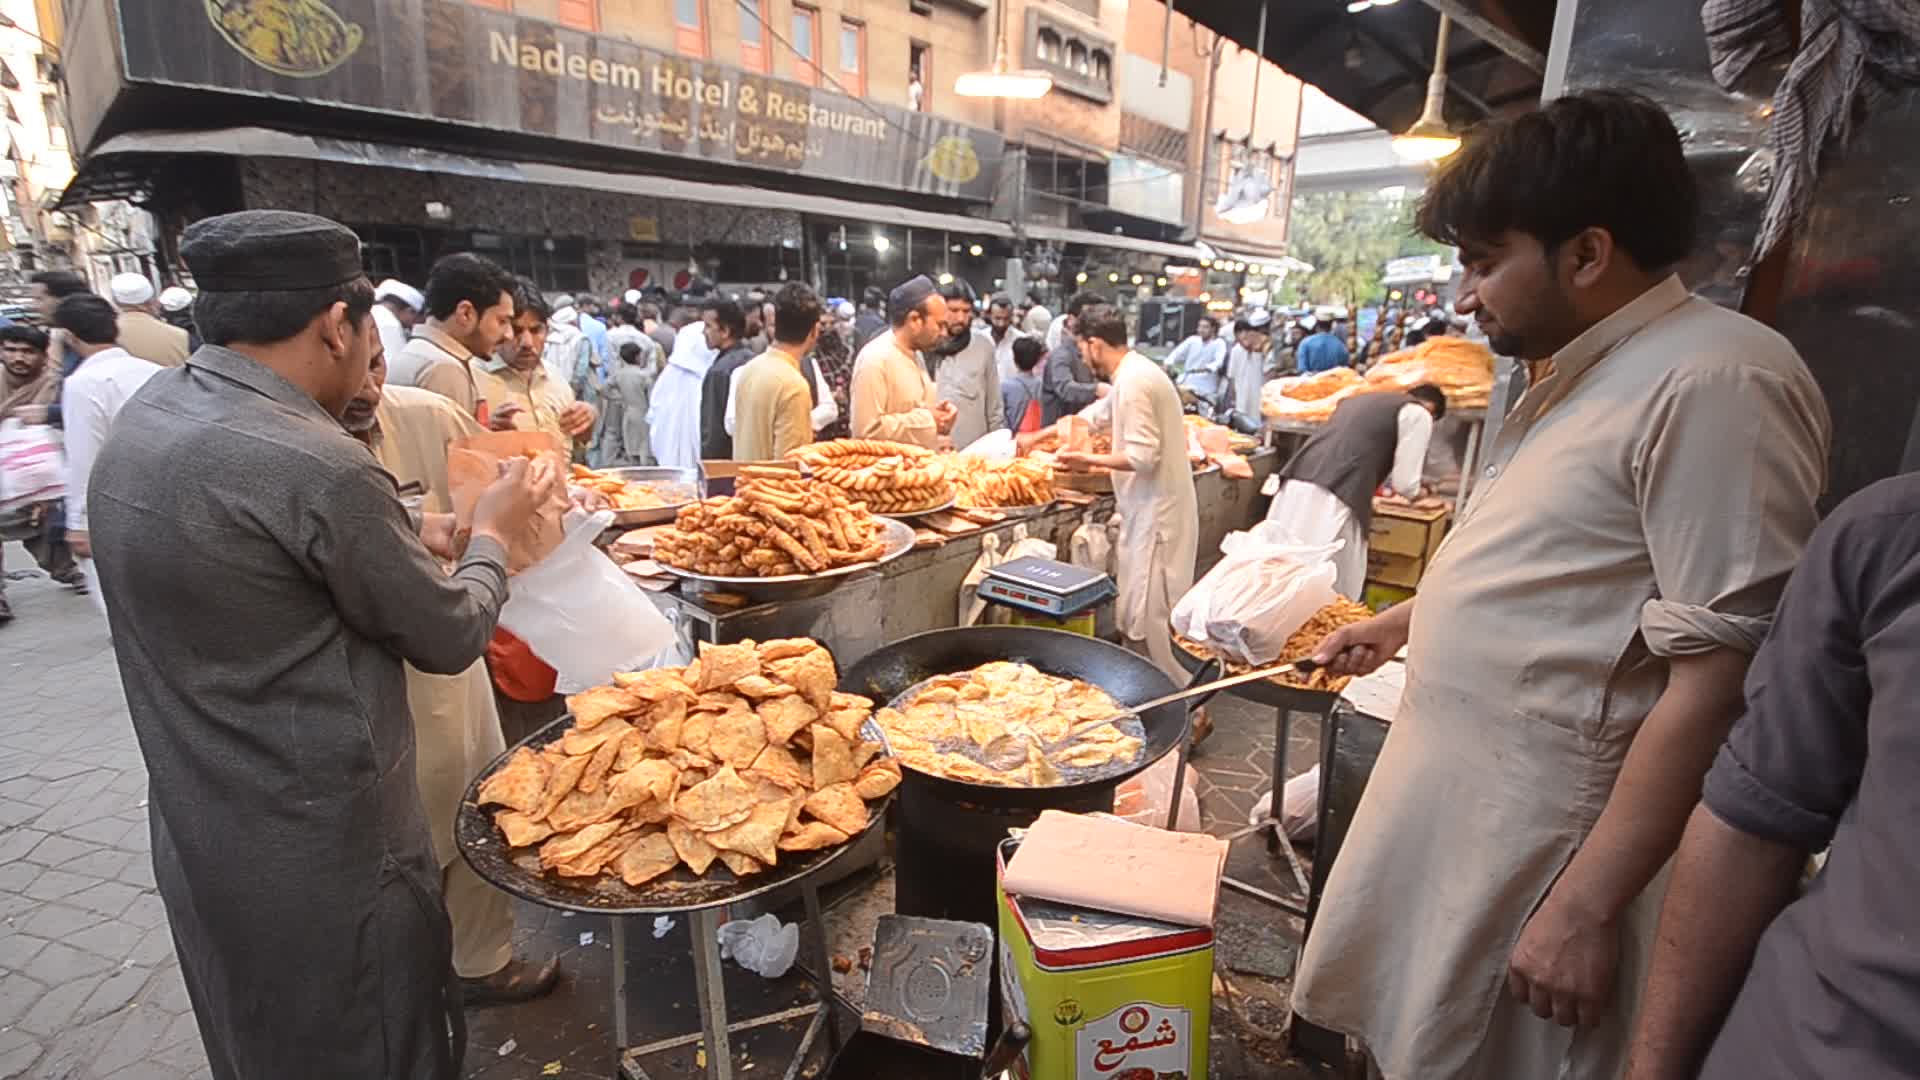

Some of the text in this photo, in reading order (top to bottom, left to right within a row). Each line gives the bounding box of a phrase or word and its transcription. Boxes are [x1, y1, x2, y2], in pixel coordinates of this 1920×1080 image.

[489, 31, 887, 140] Nadeem Hotel & Restaurant
[1094, 1018, 1177, 1072] شمع
